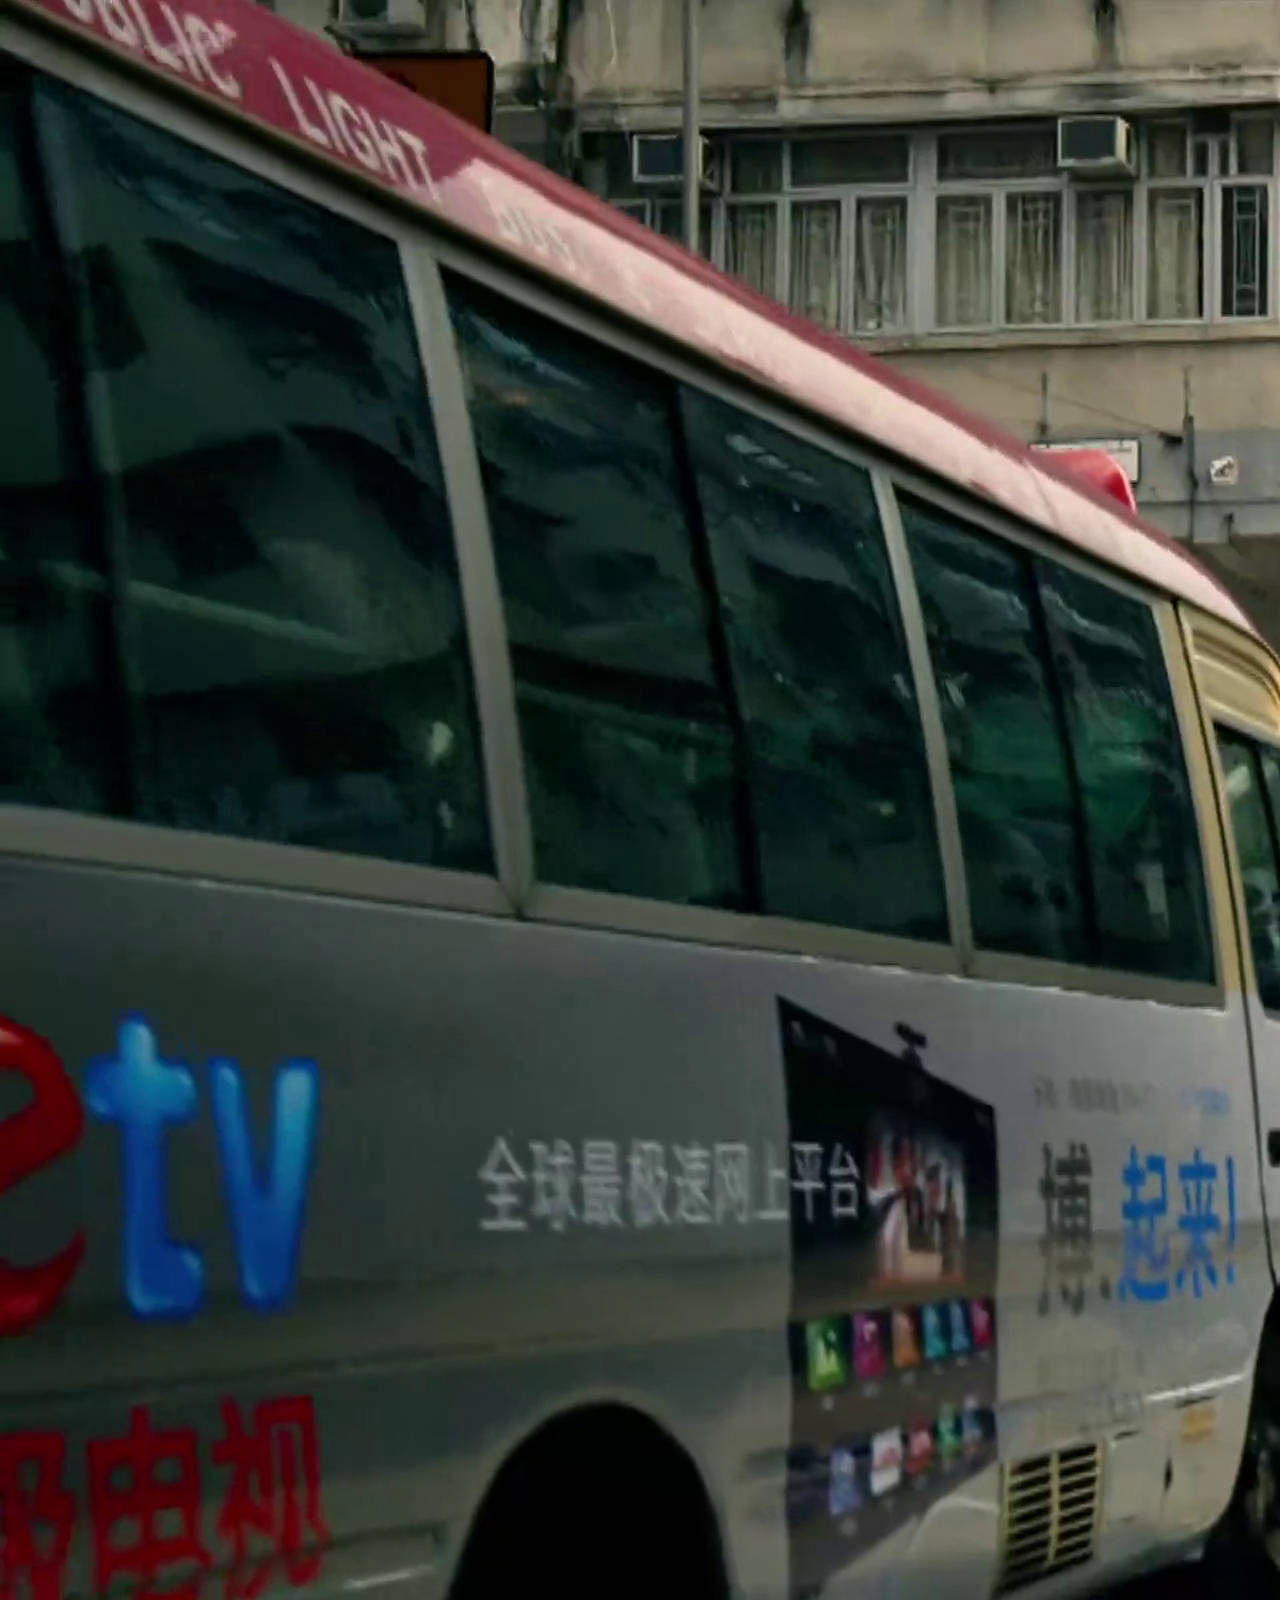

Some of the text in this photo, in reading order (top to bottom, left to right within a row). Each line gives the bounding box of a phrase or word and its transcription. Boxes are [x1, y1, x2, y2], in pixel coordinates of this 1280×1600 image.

[270, 58, 441, 205] LIGHT
[478, 1135, 861, 1232] 全球最极速网上平台
